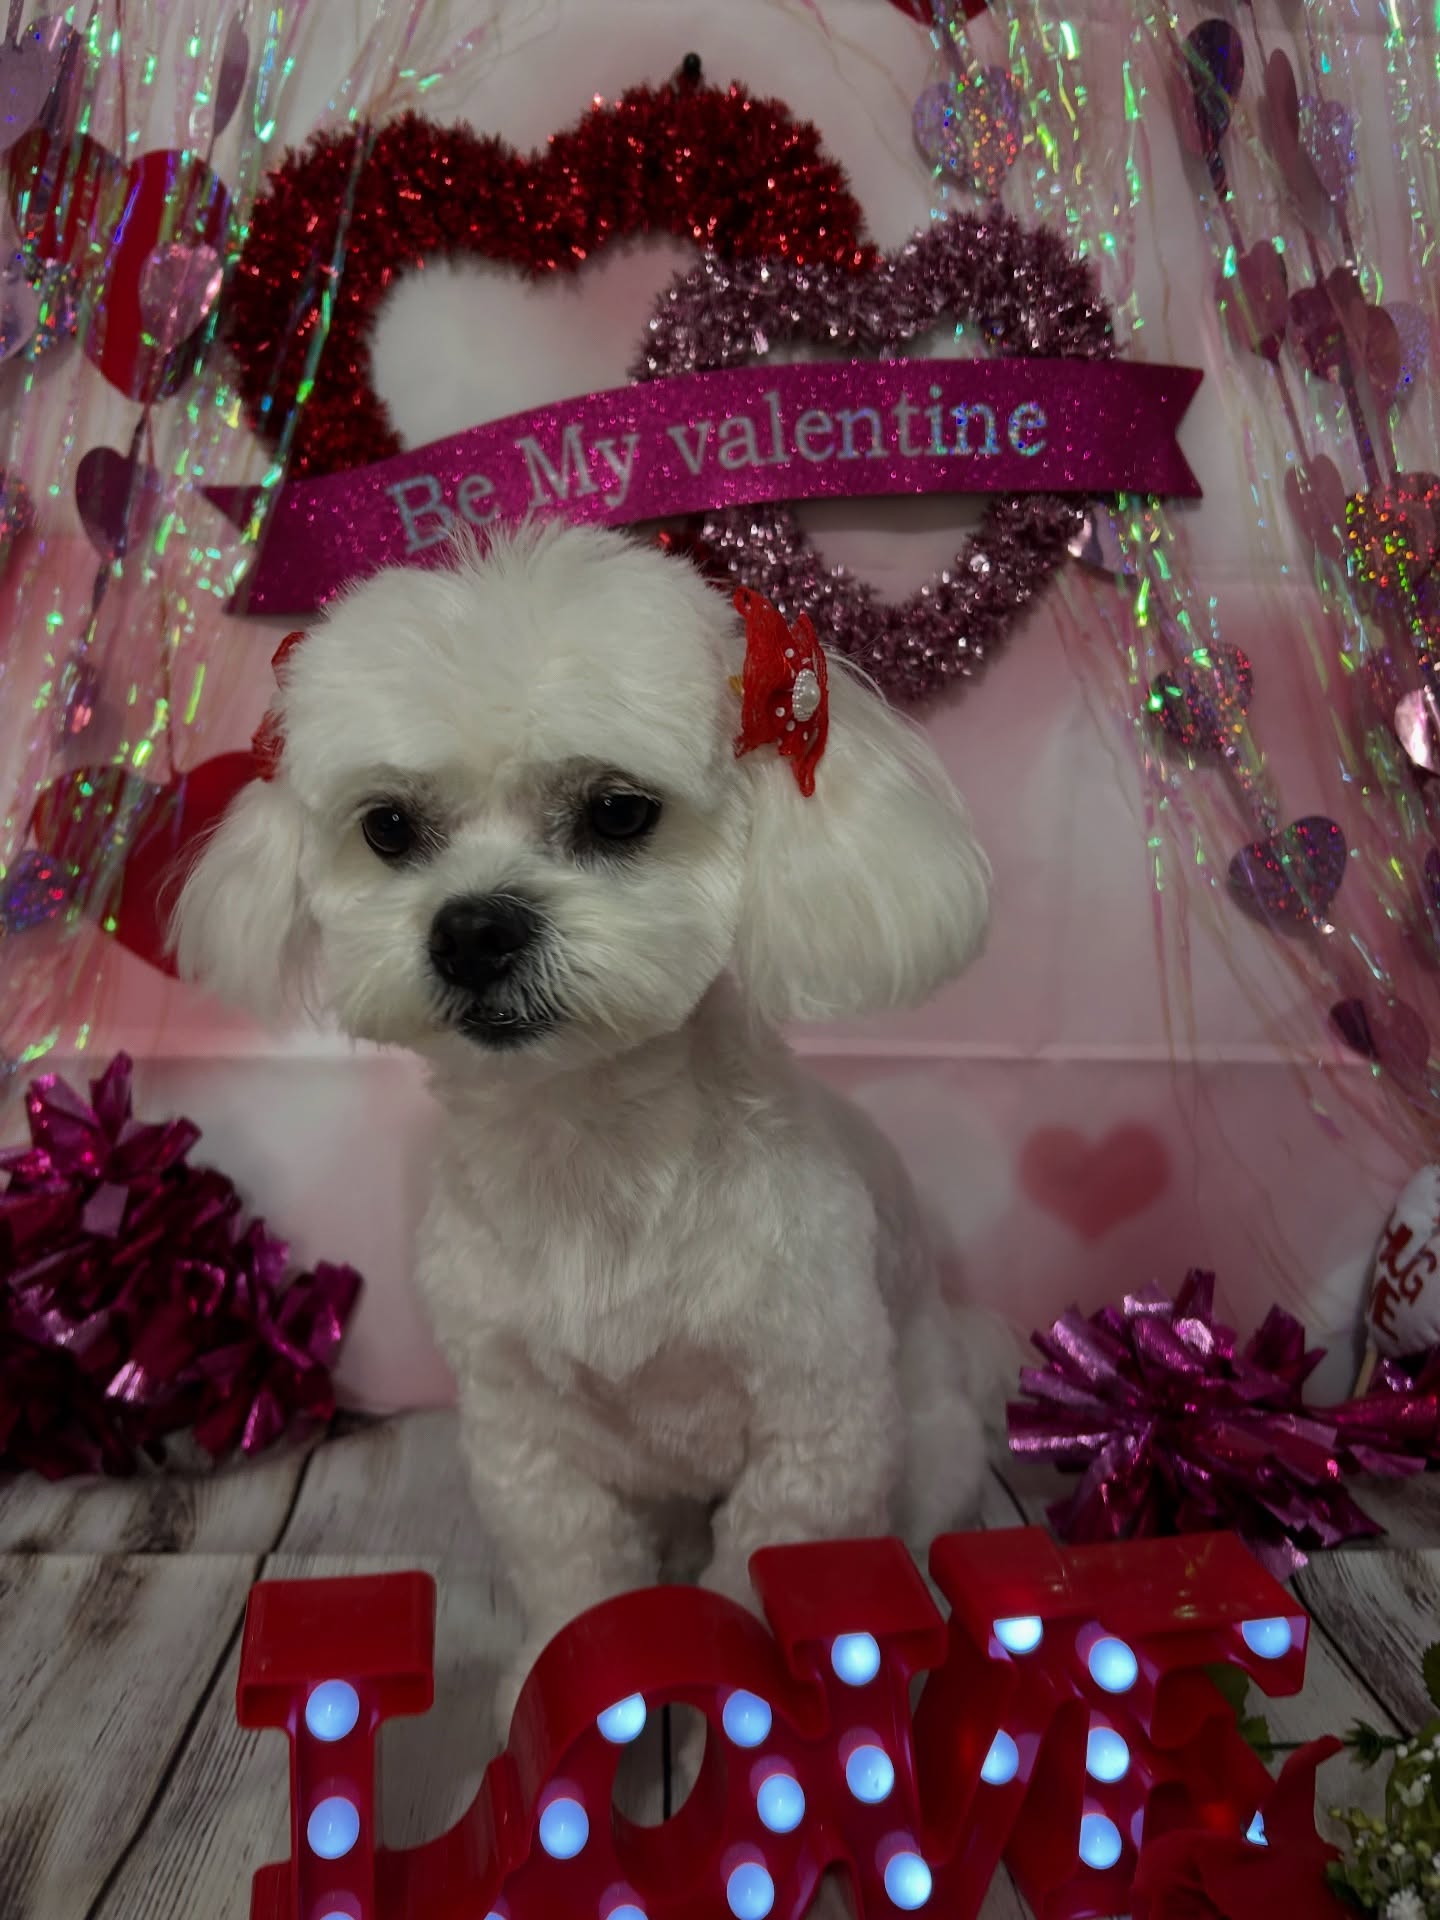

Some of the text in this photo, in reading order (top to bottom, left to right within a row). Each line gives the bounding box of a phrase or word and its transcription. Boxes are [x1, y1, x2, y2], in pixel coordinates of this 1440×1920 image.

[385, 384, 1048, 554] Be My valentine
